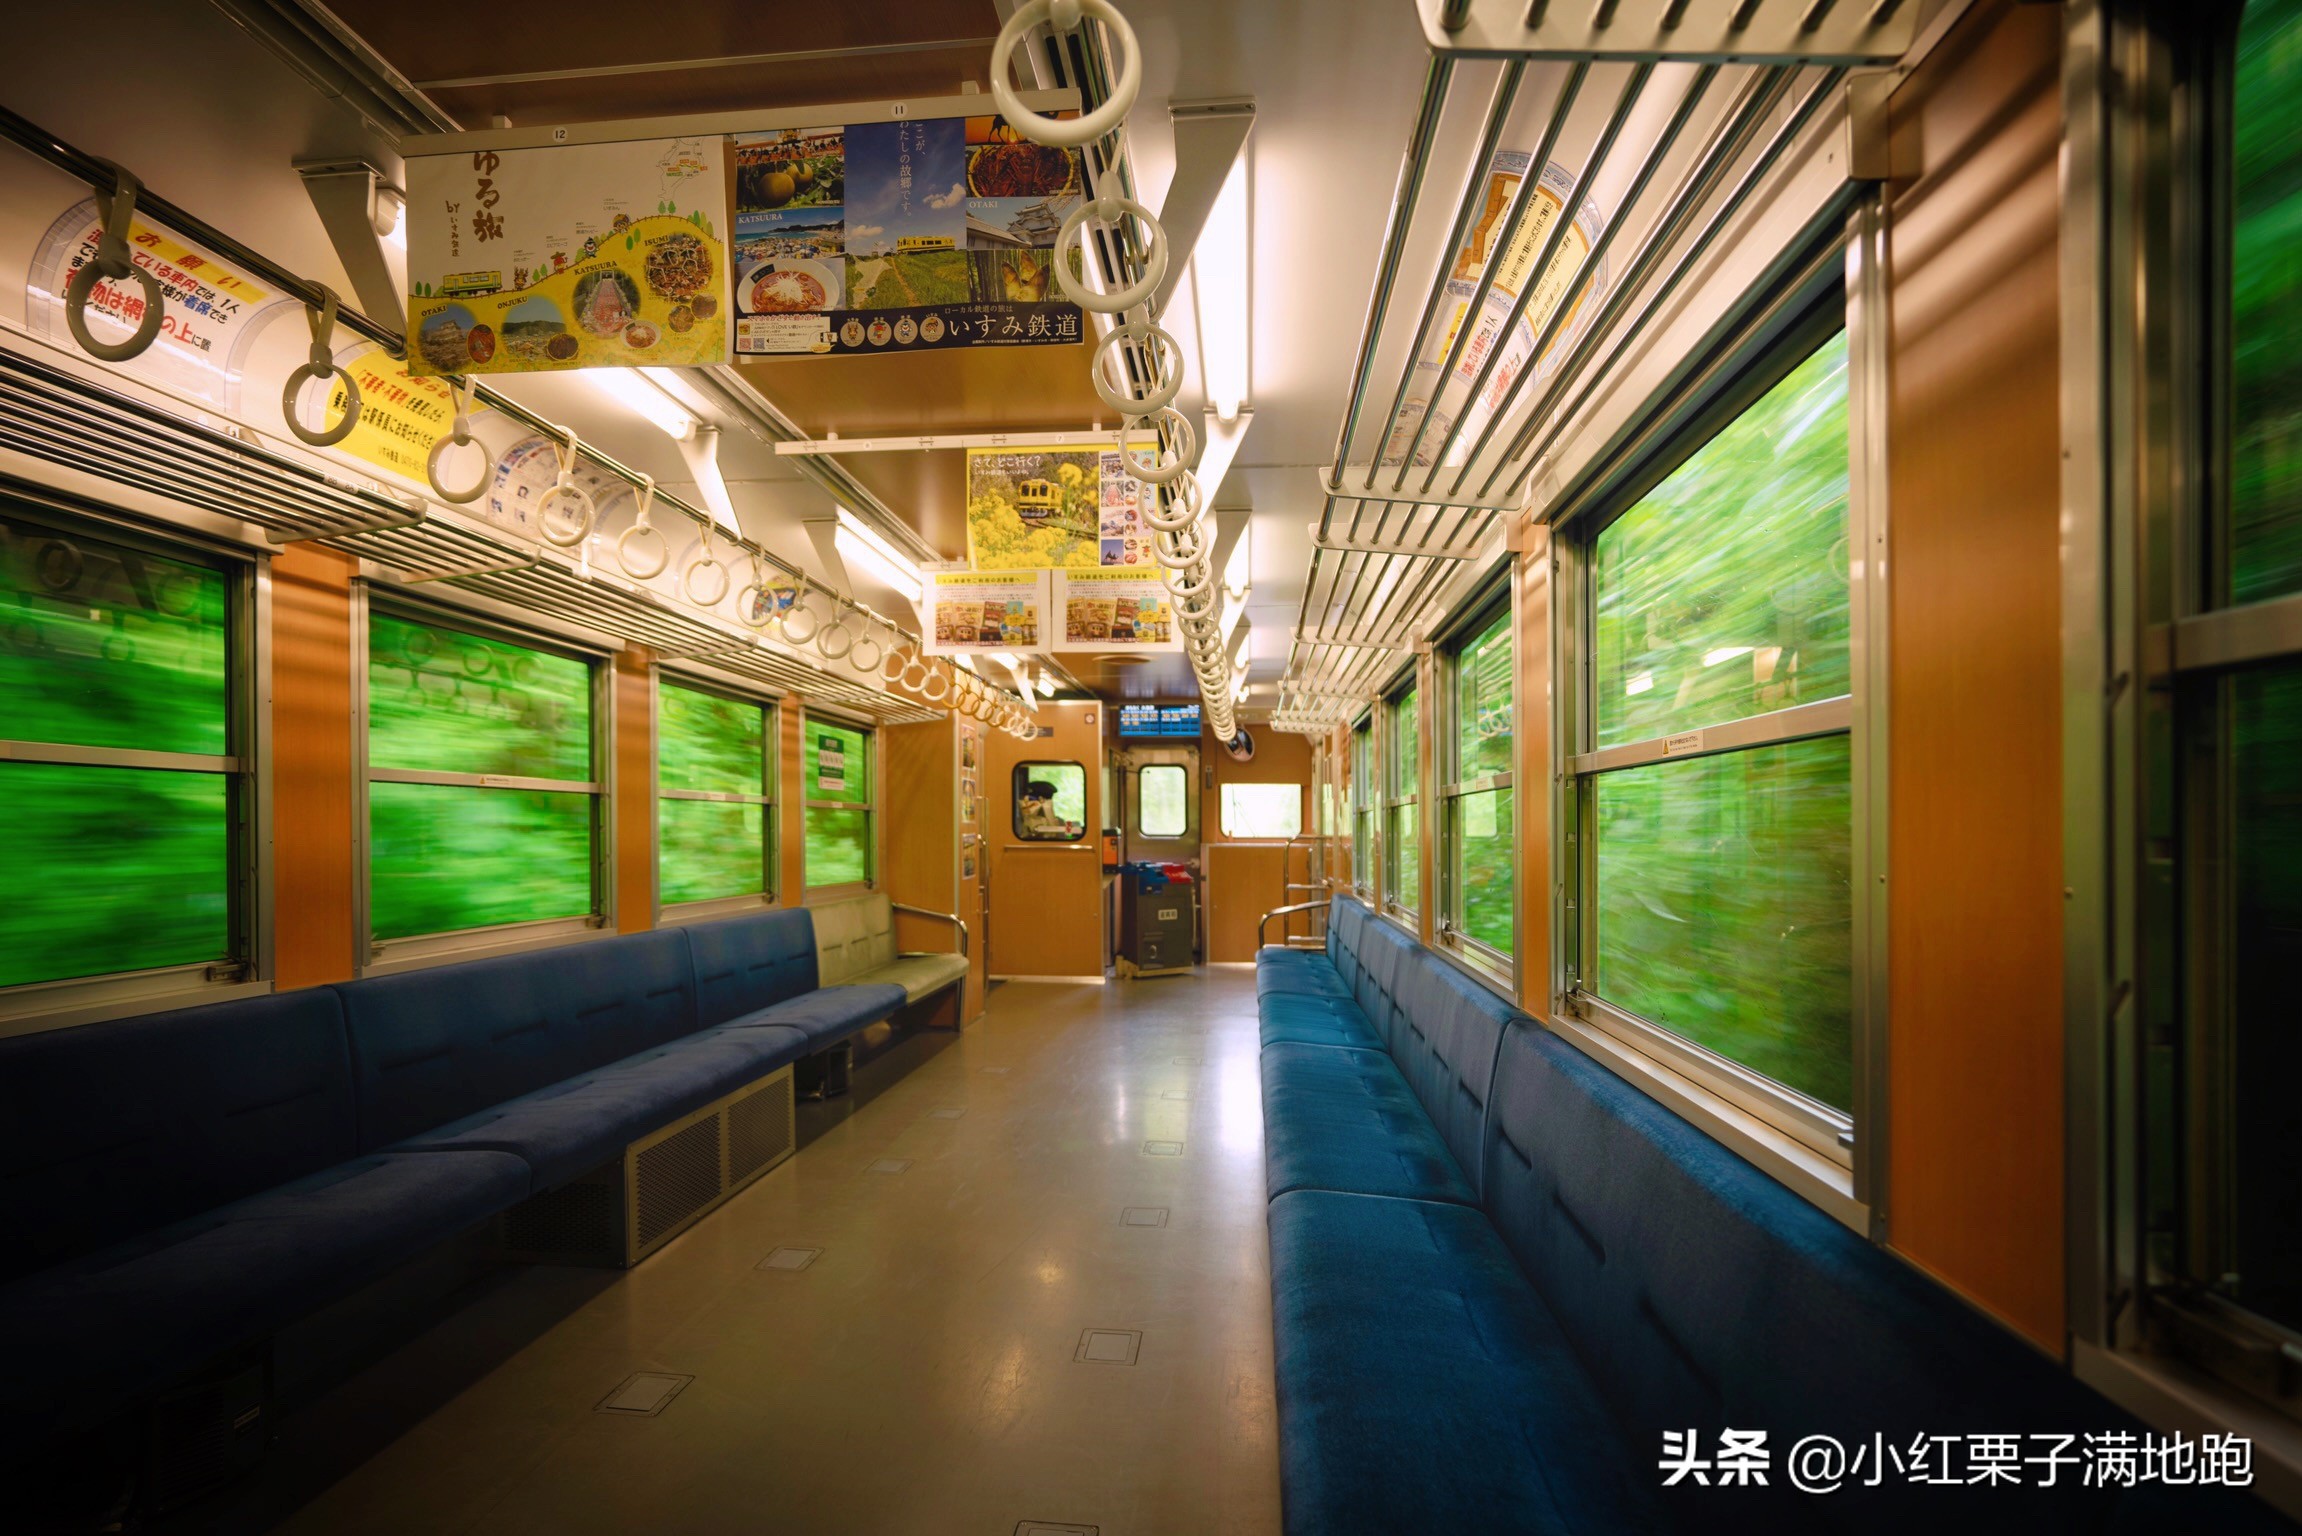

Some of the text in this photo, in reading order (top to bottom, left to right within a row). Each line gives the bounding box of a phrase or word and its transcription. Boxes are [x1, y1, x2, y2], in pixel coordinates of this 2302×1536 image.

[895, 105, 904, 115] 11
[555, 130, 566, 139] 12
[472, 151, 505, 243] ゆる旅
[969, 201, 998, 209] OTAKI
[738, 213, 783, 224] KATSUURA
[644, 235, 669, 246] ISUMI
[574, 261, 618, 276] KATSUURA
[497, 296, 528, 310] ONJUKU
[421, 305, 447, 317] OTAKI
[944, 305, 1014, 314] ローカル鉄道の旅は
[950, 314, 1078, 338] いすみ鉄道
